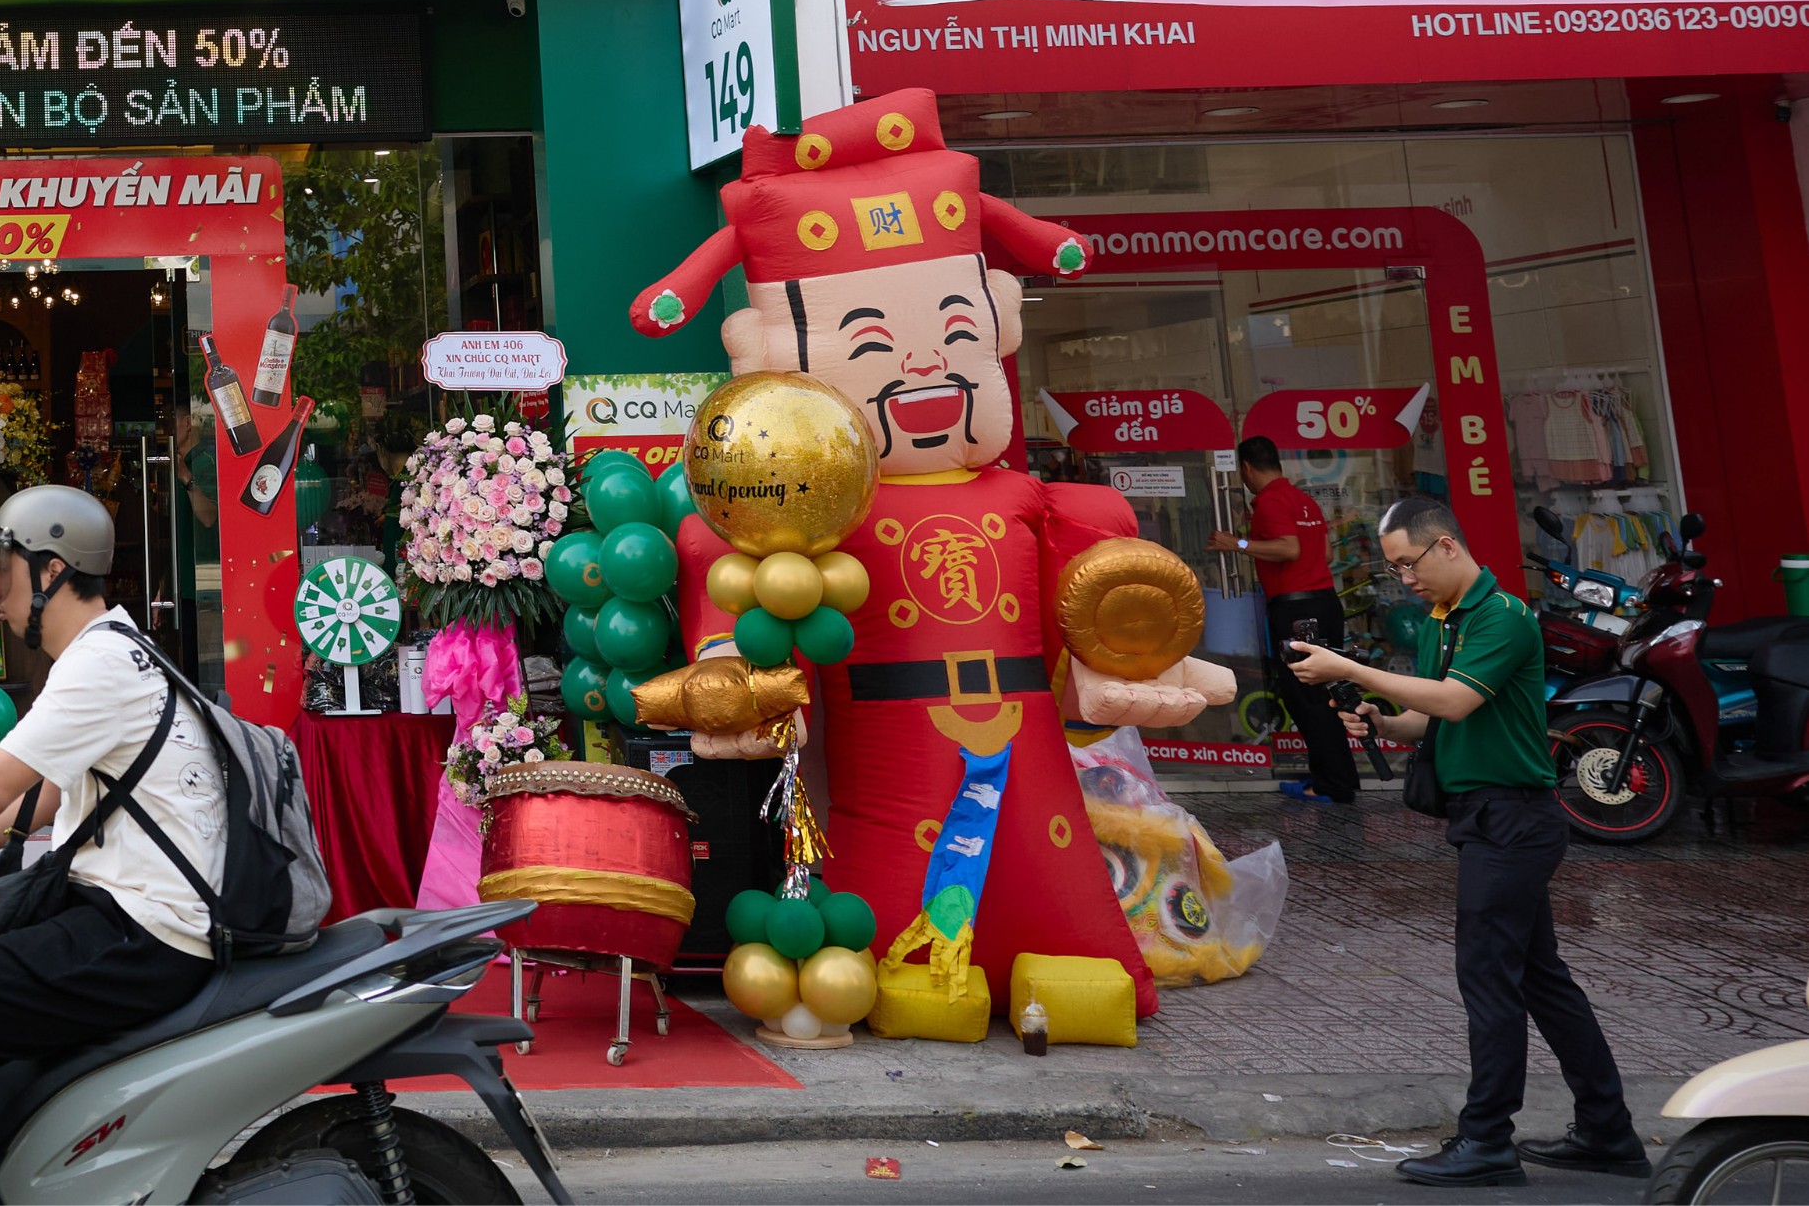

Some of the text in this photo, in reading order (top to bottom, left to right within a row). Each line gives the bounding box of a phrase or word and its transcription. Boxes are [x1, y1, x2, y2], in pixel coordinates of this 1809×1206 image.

[710, 7, 742, 40] CQ Mart
[857, 15, 1195, 54] NGUYỄN THỊ MINH KHAI
[75, 21, 178, 70] ĐẾN
[194, 27, 291, 70] 50%
[43, 81, 109, 135] BỘ
[123, 78, 223, 128] SẢN
[236, 76, 367, 125] PHẨM
[704, 40, 756, 144] 149
[178, 165, 263, 206] MÃI
[445, 351, 541, 366] XIN CHÚC CQ MART
[461, 340, 524, 350] ANH EM 406
[624, 400, 658, 419] CQ
[1084, 392, 1185, 420] Giảm giá
[1295, 395, 1377, 440] 50%
[1114, 417, 1159, 443] đến
[694, 444, 745, 464] CQ Mart
[718, 479, 787, 507] Opening
[1192, 745, 1267, 765] xin chào
